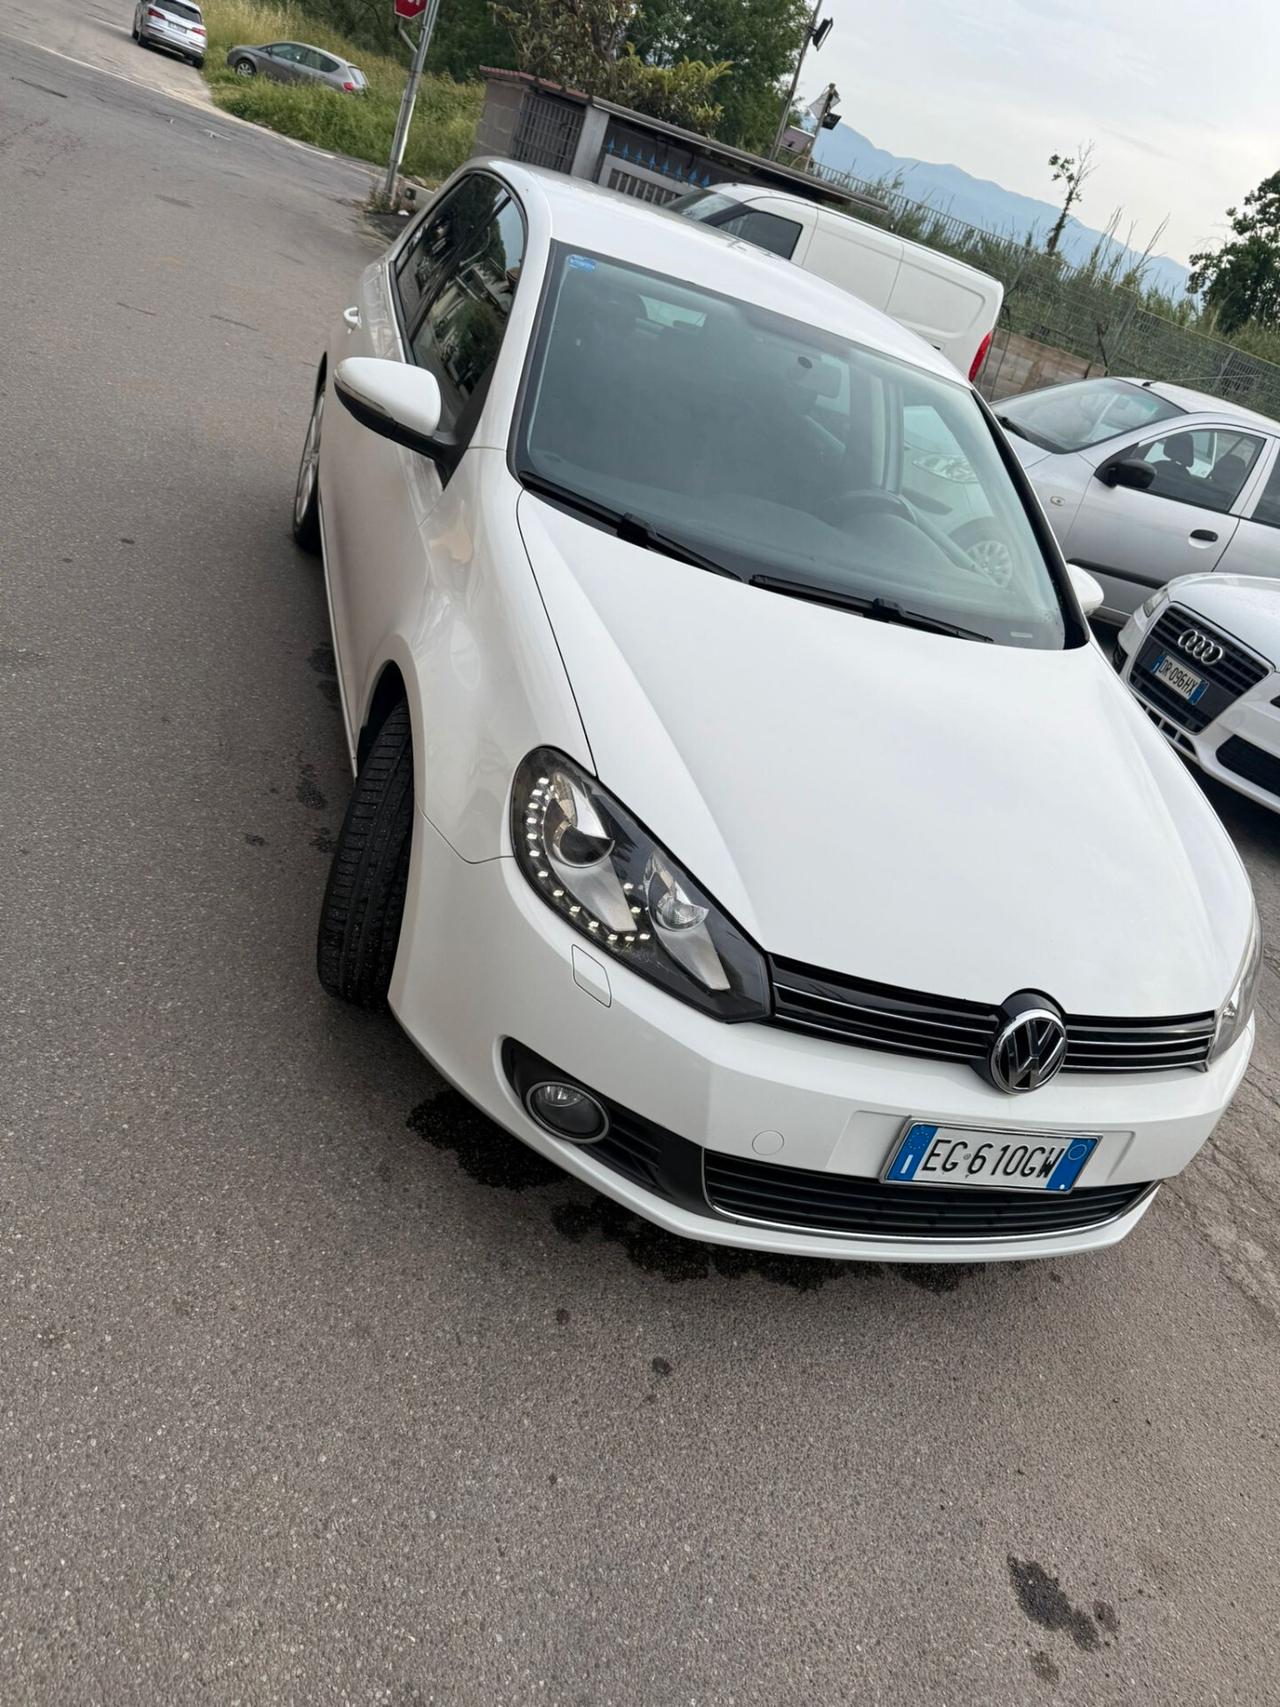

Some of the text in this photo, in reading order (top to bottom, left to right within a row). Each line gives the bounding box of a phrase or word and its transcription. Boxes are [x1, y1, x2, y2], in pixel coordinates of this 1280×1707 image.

[1159, 660, 1198, 694] DR 096HX
[921, 1139, 1065, 1178] EG 610GW
